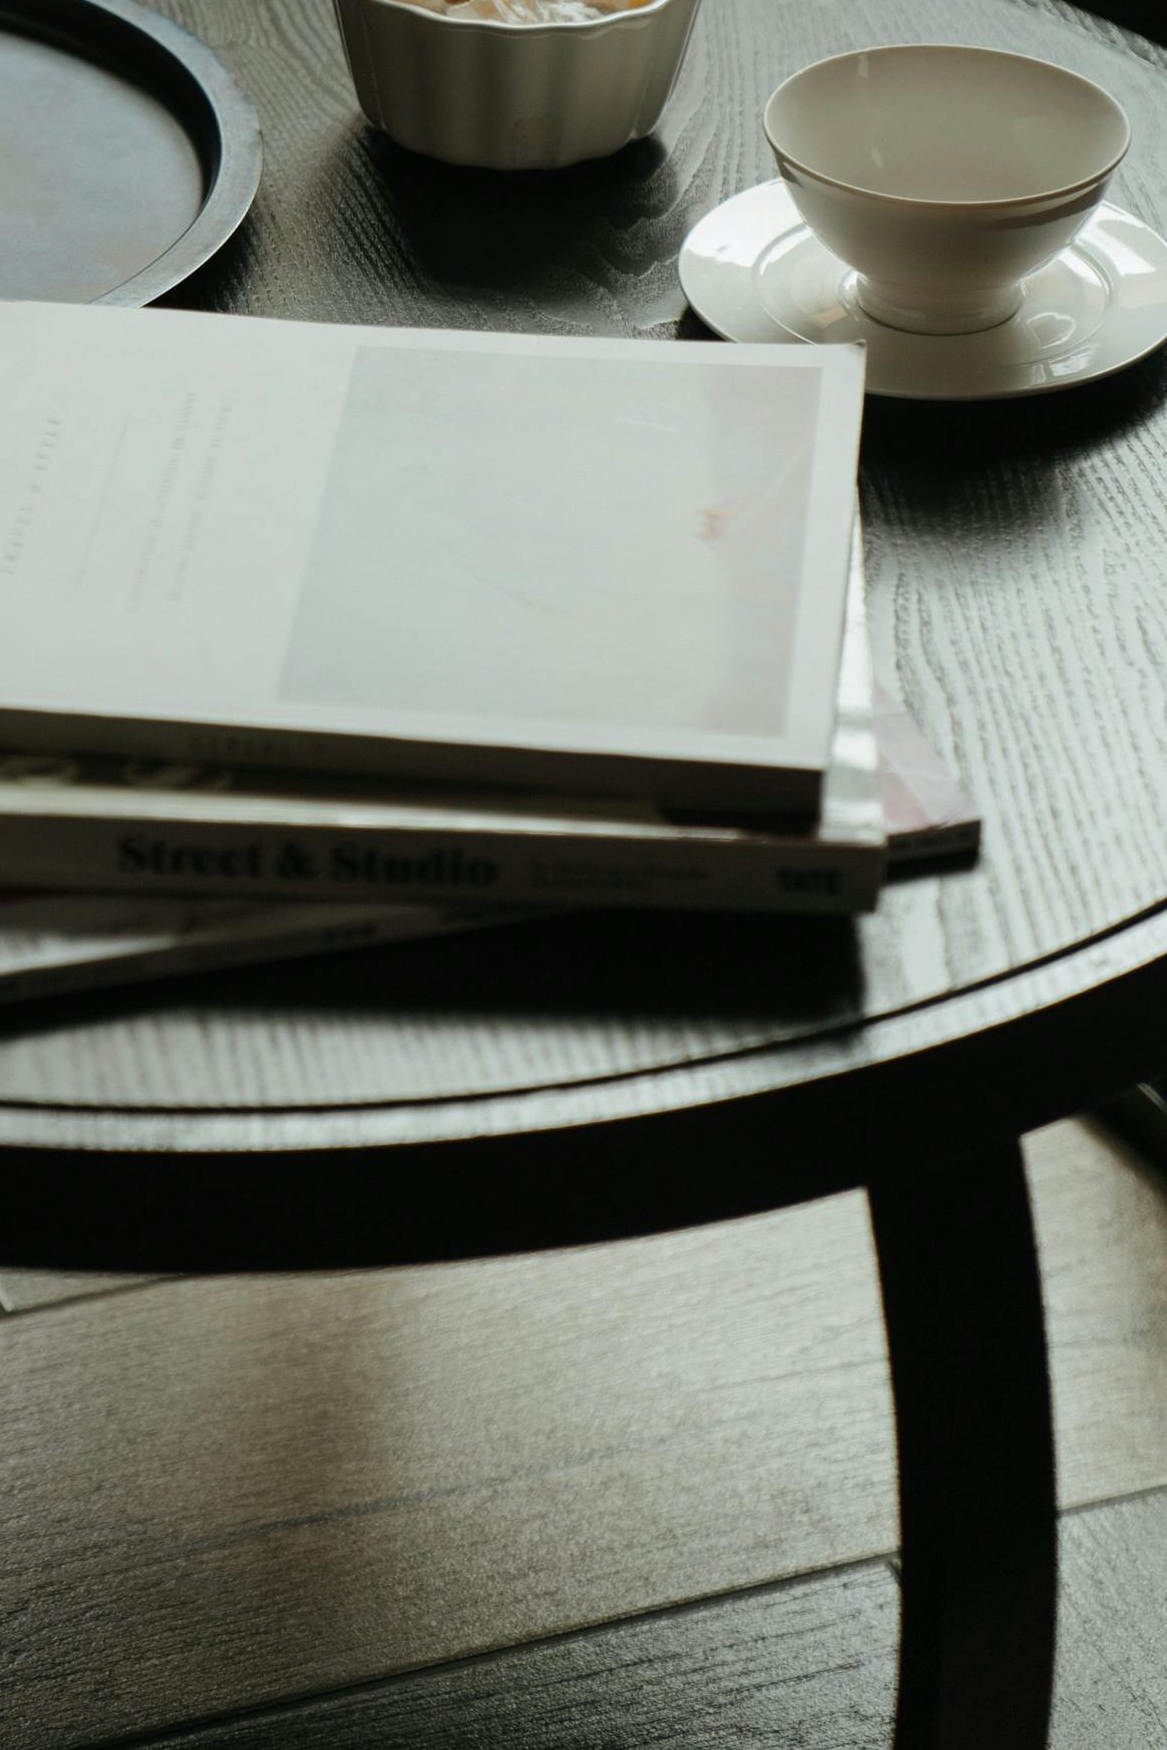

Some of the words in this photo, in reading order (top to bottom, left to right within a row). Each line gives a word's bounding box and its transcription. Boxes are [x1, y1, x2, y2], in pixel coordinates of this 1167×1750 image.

[118, 836, 263, 877] Street
[274, 842, 320, 881] &
[331, 842, 501, 885] Studio
[776, 865, 843, 897] TATE
